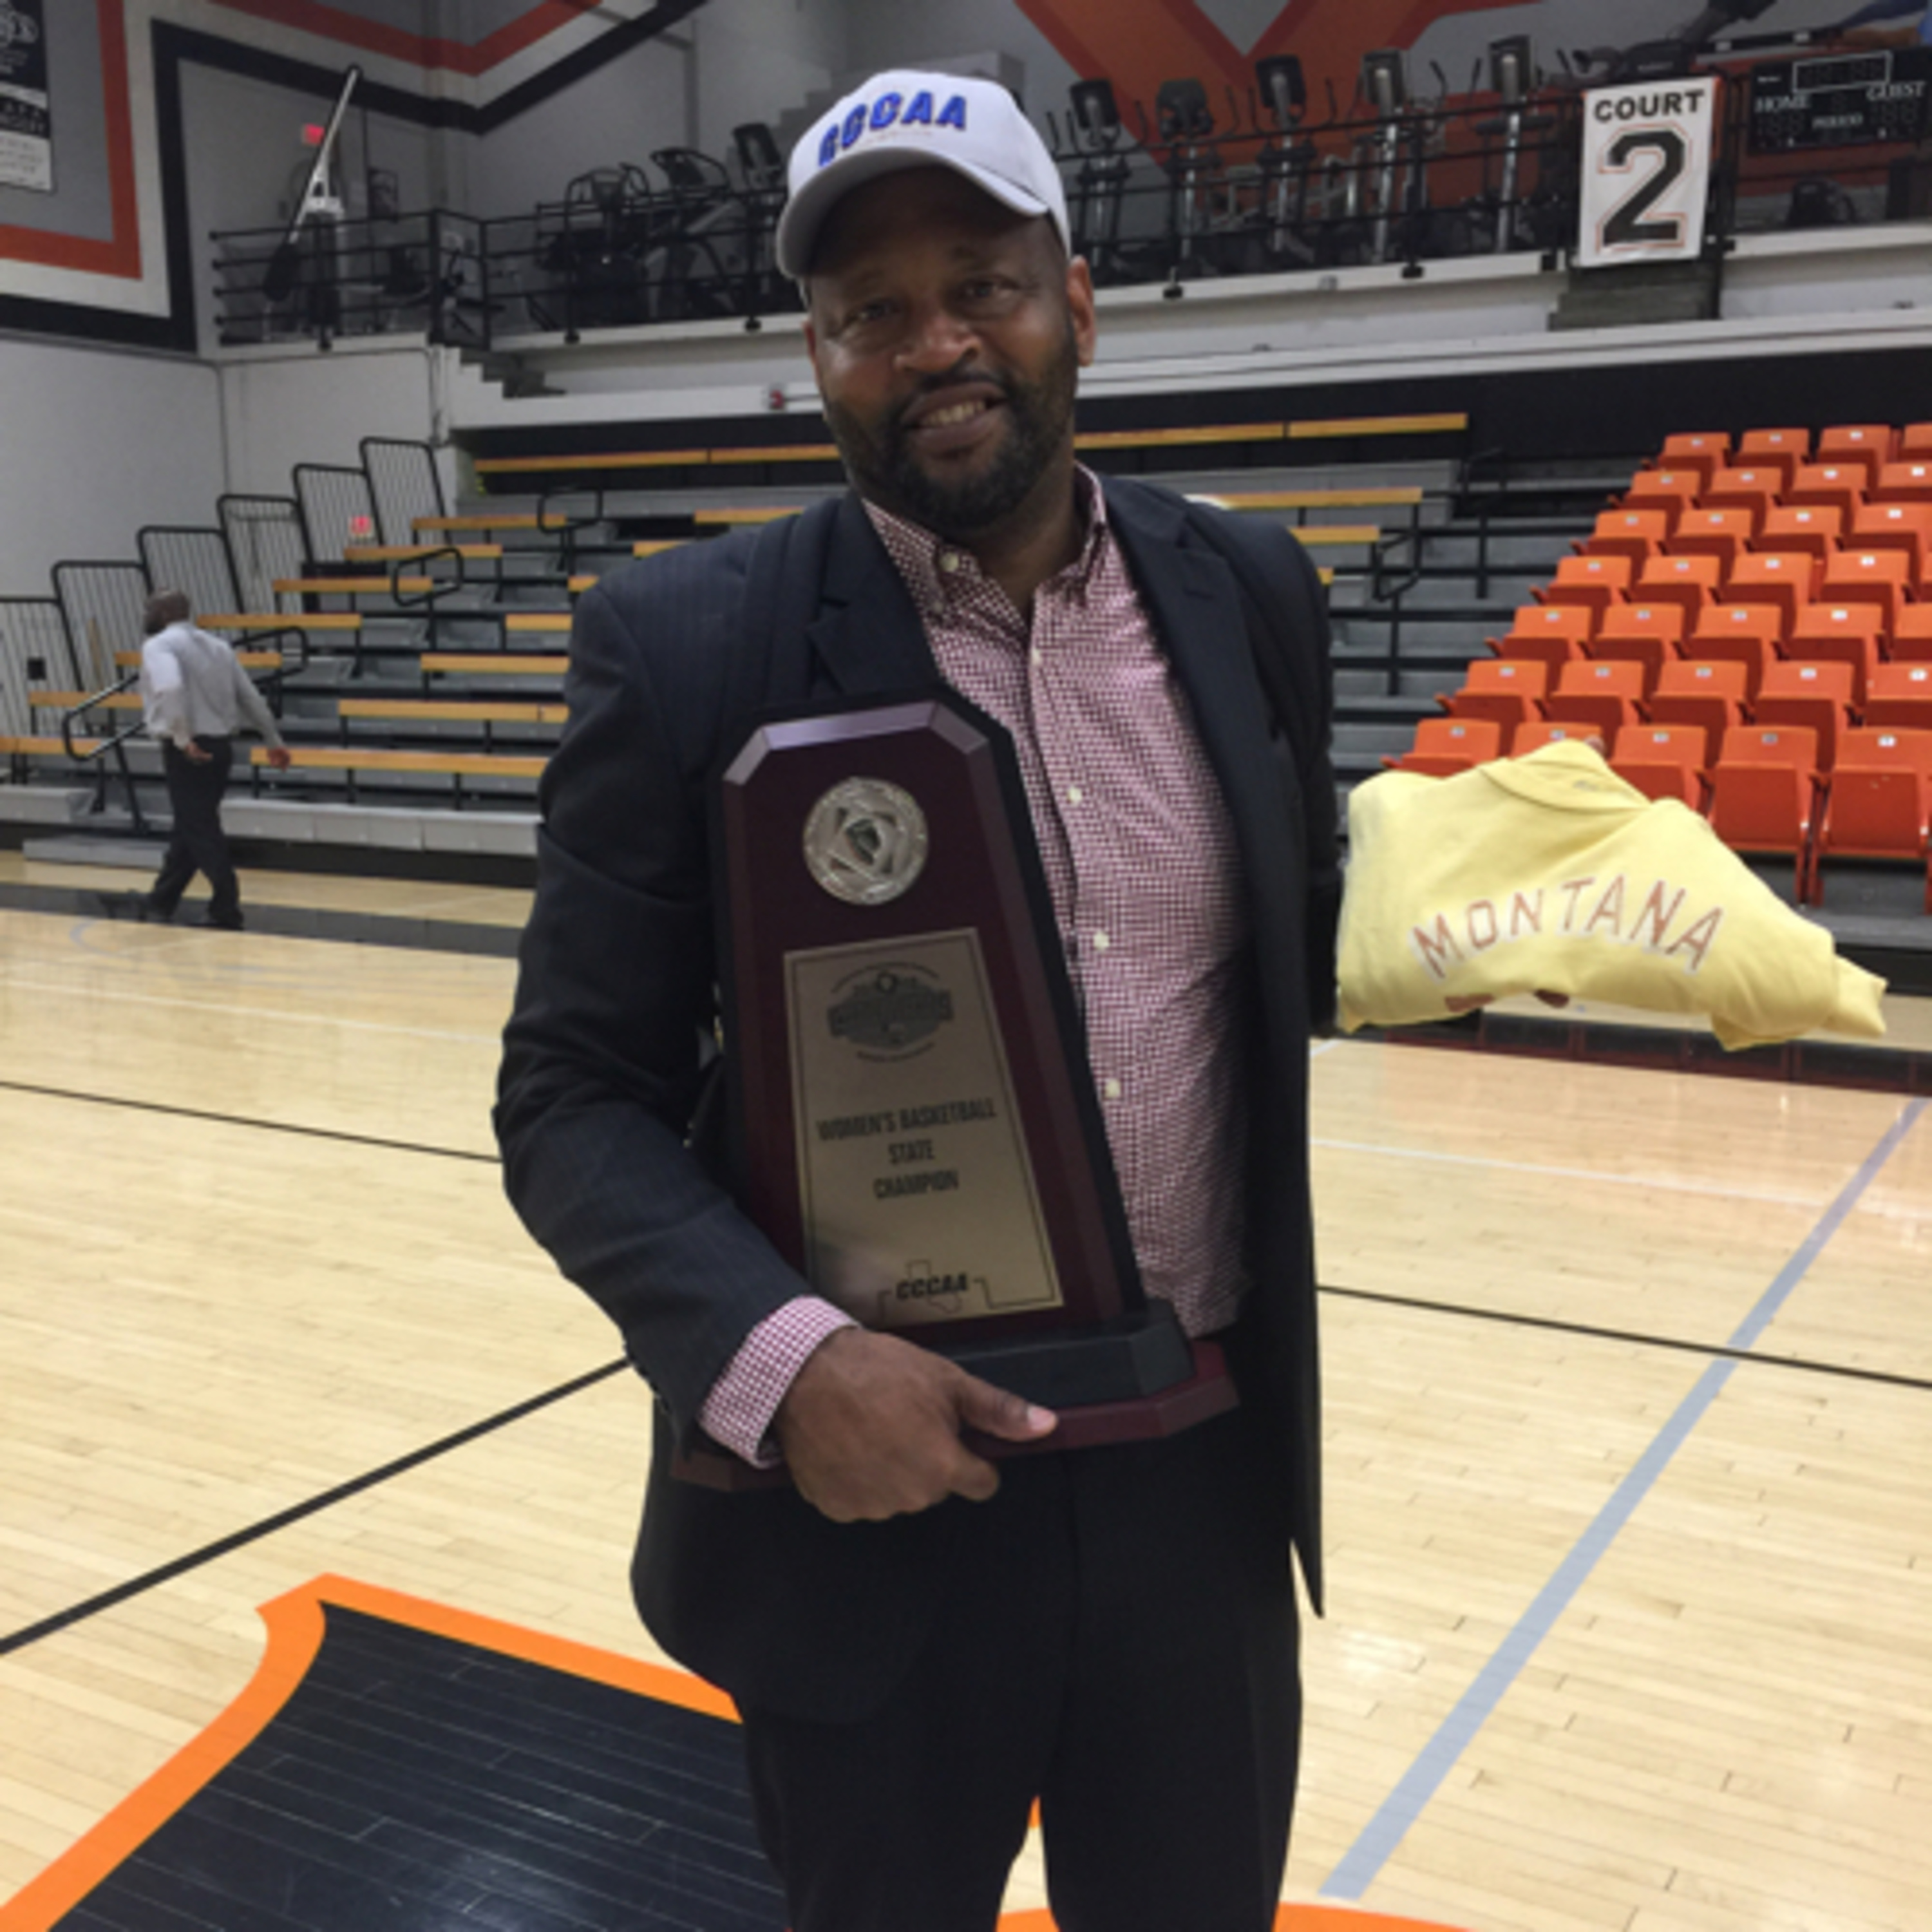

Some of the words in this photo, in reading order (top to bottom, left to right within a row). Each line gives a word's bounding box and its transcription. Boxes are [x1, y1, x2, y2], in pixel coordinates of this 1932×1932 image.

[1594, 89, 1705, 122] COURT
[1754, 95, 1811, 113] HOME
[1596, 124, 1692, 254] 2
[1410, 874, 1724, 980] MONTANA
[816, 1110, 896, 1141] WOMEN'S
[900, 1097, 997, 1130] BASKETBALL
[888, 1138, 934, 1165] STATE
[873, 1169, 960, 1199] CHAMPION
[896, 1271, 968, 1301] CCCAA
